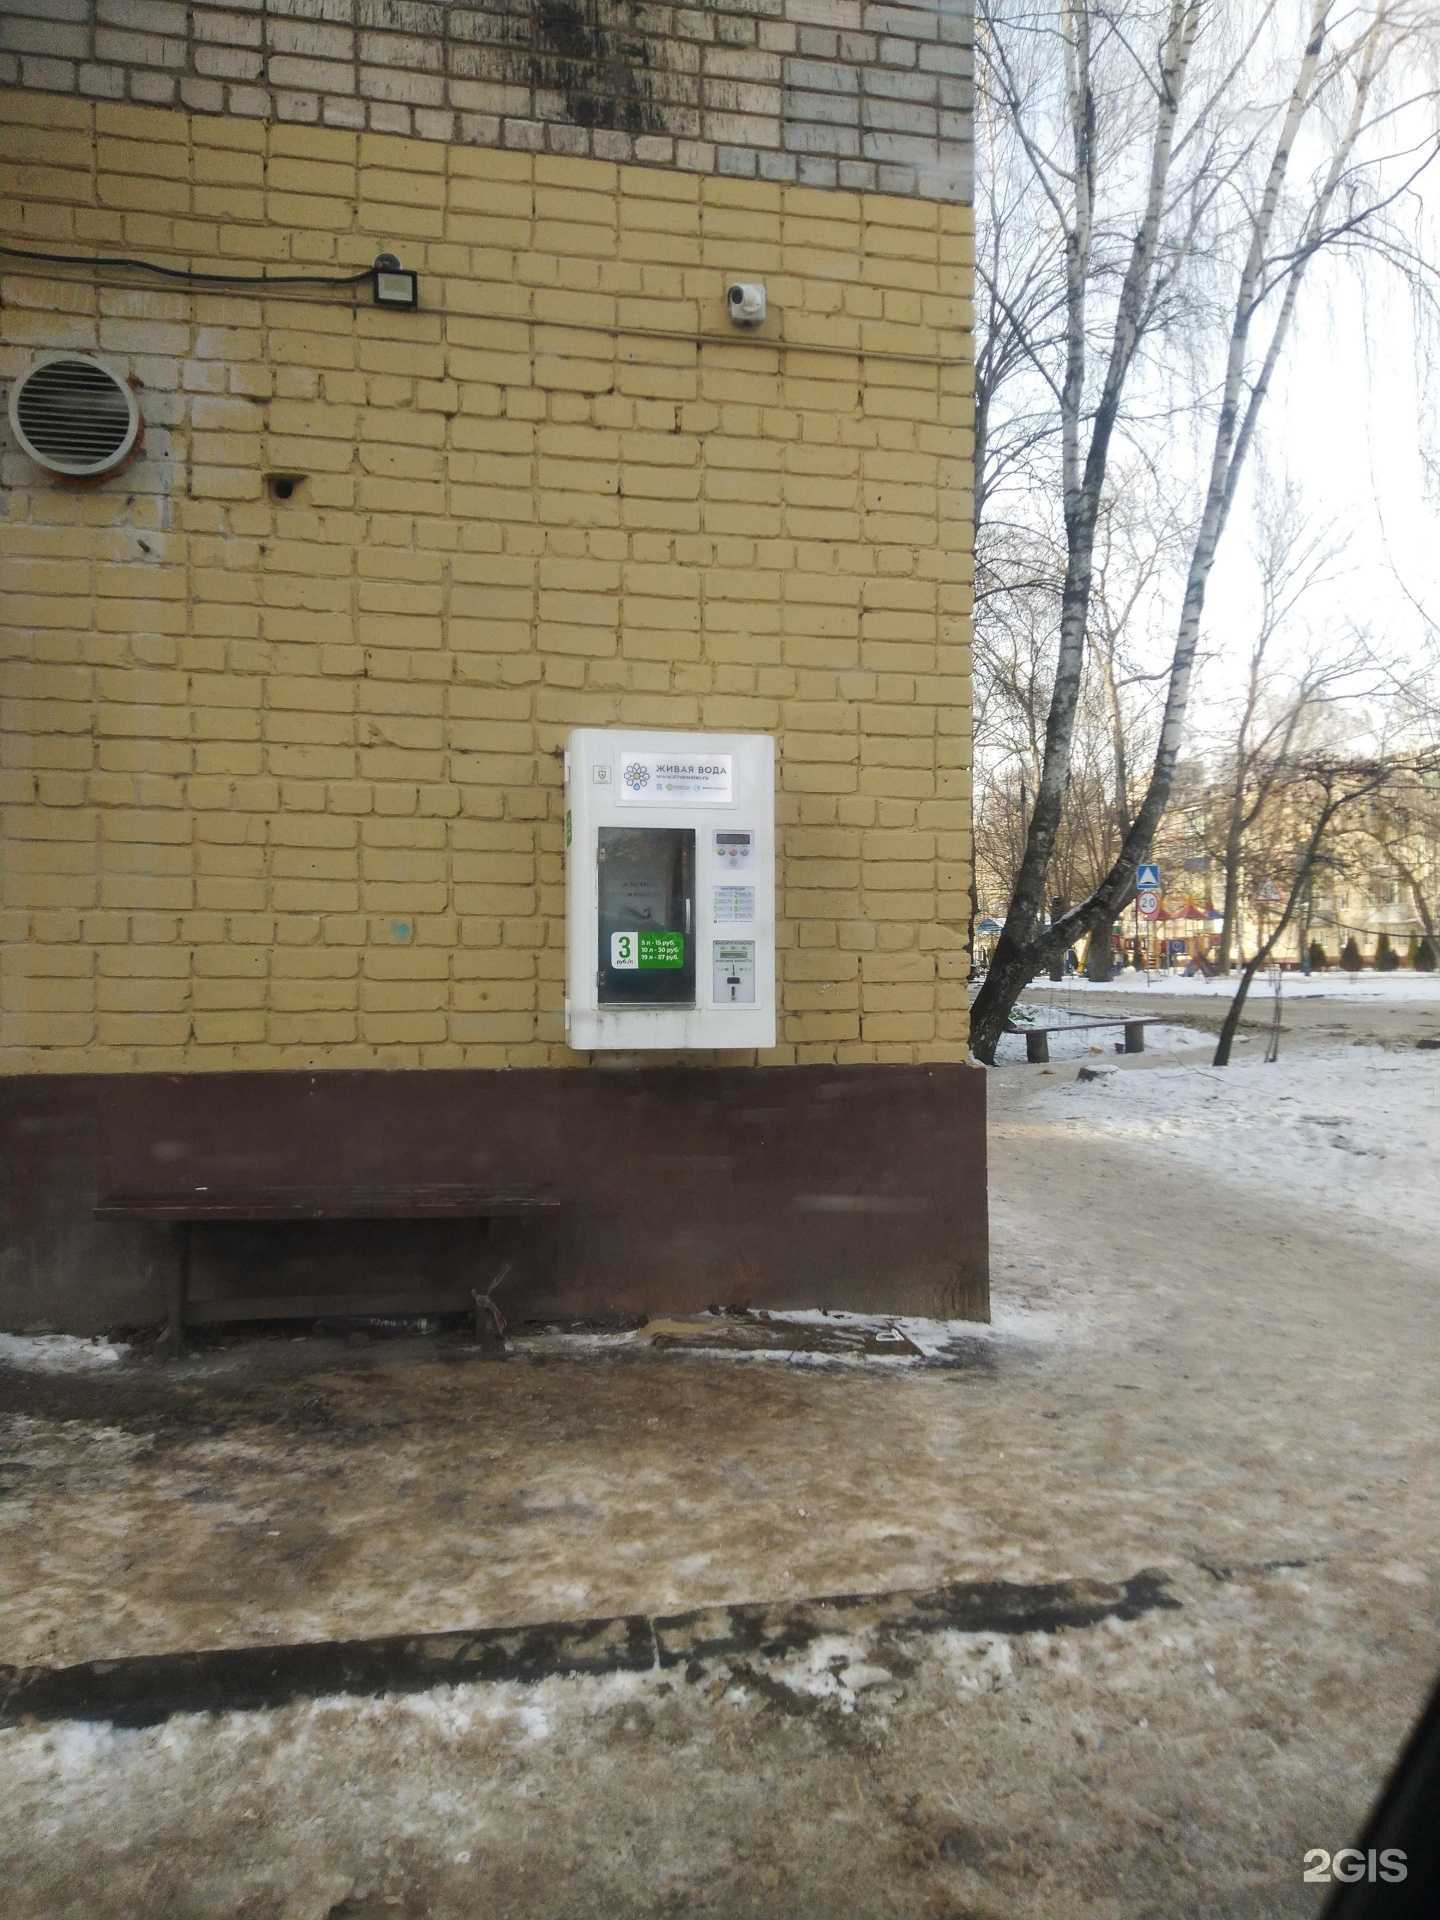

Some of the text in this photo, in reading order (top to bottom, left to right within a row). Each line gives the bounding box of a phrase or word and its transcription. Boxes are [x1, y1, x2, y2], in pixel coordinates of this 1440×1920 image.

[656, 765, 727, 775] ЖИВАЯ ВОДА
[1142, 897, 1155, 908] 20
[618, 936, 631, 958] 3
